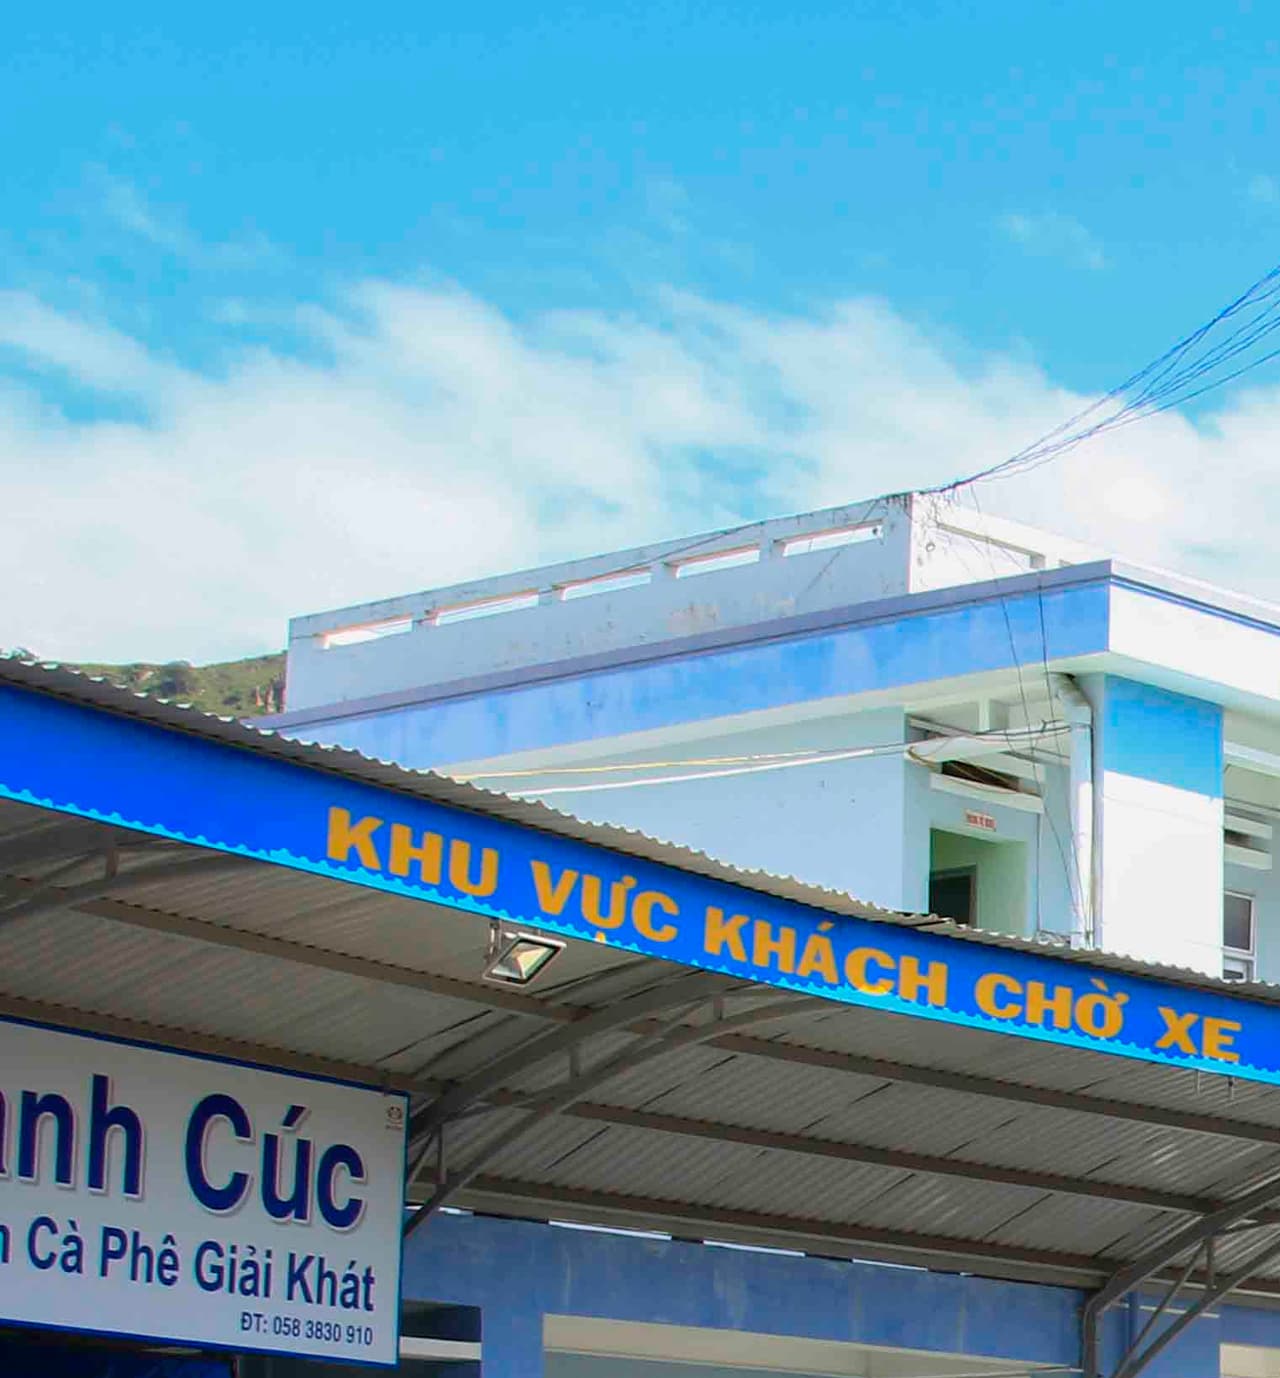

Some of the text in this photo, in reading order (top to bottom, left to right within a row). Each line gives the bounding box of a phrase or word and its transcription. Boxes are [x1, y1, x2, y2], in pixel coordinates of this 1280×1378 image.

[326, 807, 1242, 1062] KHU VỰC KHÁCH CHỜ XE
[0, 1074, 366, 1230] nh Cúc
[27, 1216, 84, 1274] Cà
[100, 1226, 181, 1287] Phê
[195, 1240, 272, 1299] Giải
[287, 1251, 376, 1311] Khát
[241, 1311, 374, 1346] ĐT: 058 3830 910
